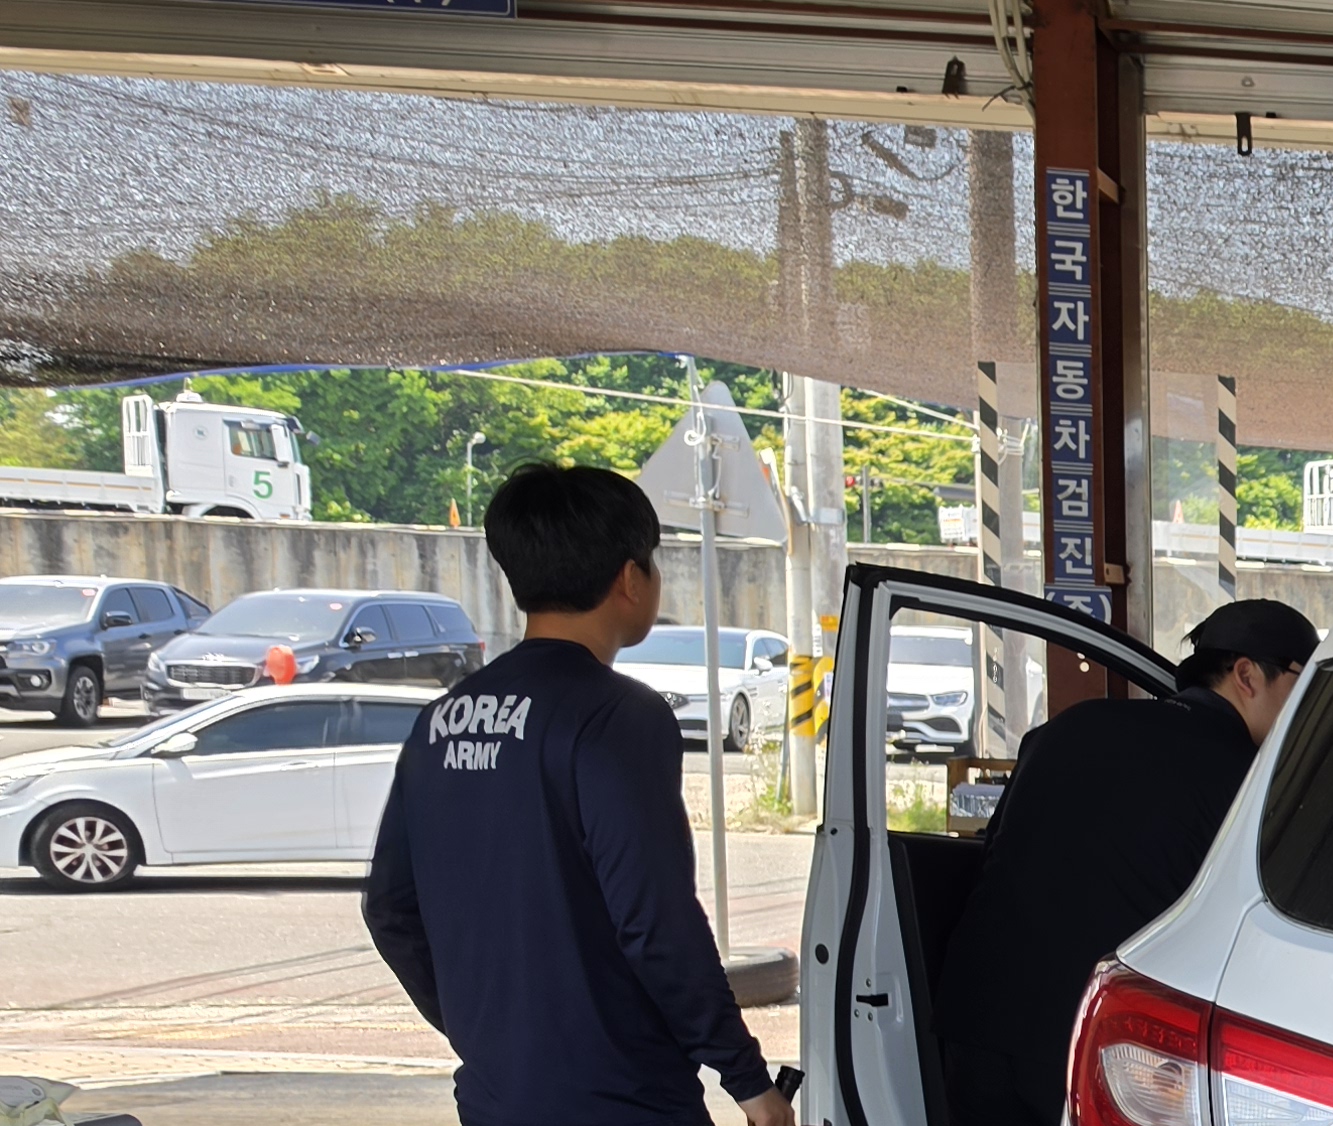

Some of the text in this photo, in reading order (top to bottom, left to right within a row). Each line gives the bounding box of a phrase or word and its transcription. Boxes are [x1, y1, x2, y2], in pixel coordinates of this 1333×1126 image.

[253, 471, 273, 499] 5
[429, 694, 532, 745] KOREA
[443, 740, 502, 771] ARMY
